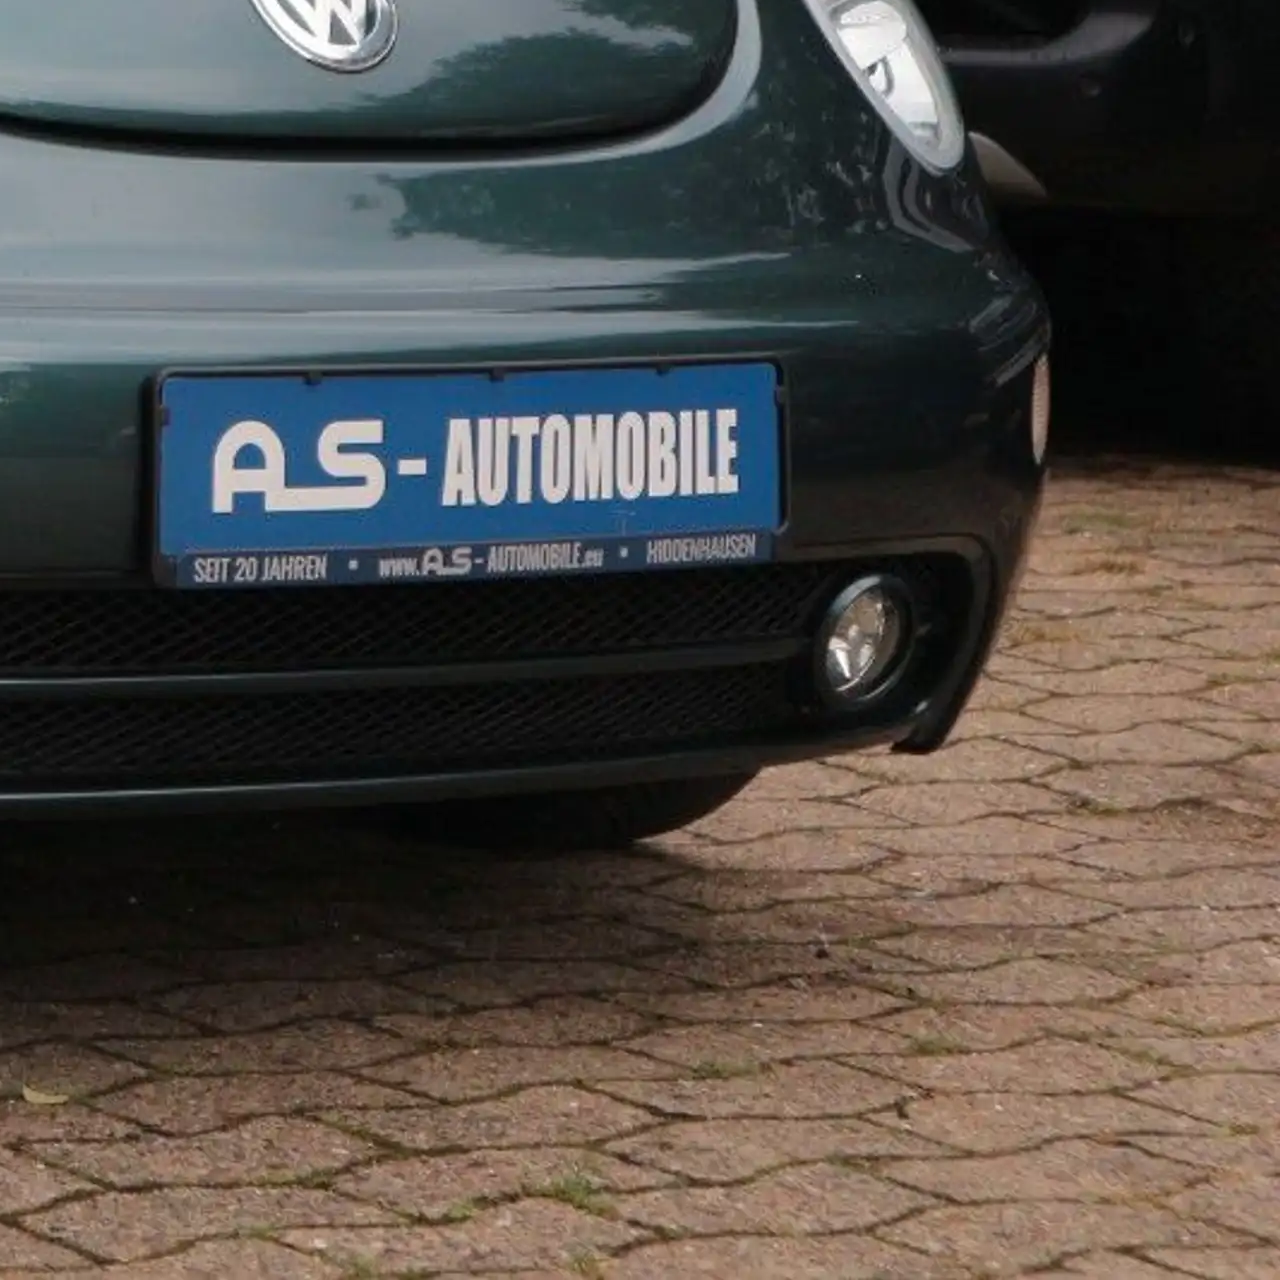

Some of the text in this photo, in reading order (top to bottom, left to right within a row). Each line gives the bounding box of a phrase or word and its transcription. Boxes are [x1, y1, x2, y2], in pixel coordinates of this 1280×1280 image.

[212, 408, 738, 513] AS-AUTOMOBILE
[193, 555, 231, 583] SEIT
[234, 556, 257, 582] 20
[261, 553, 328, 581] JAHREN
